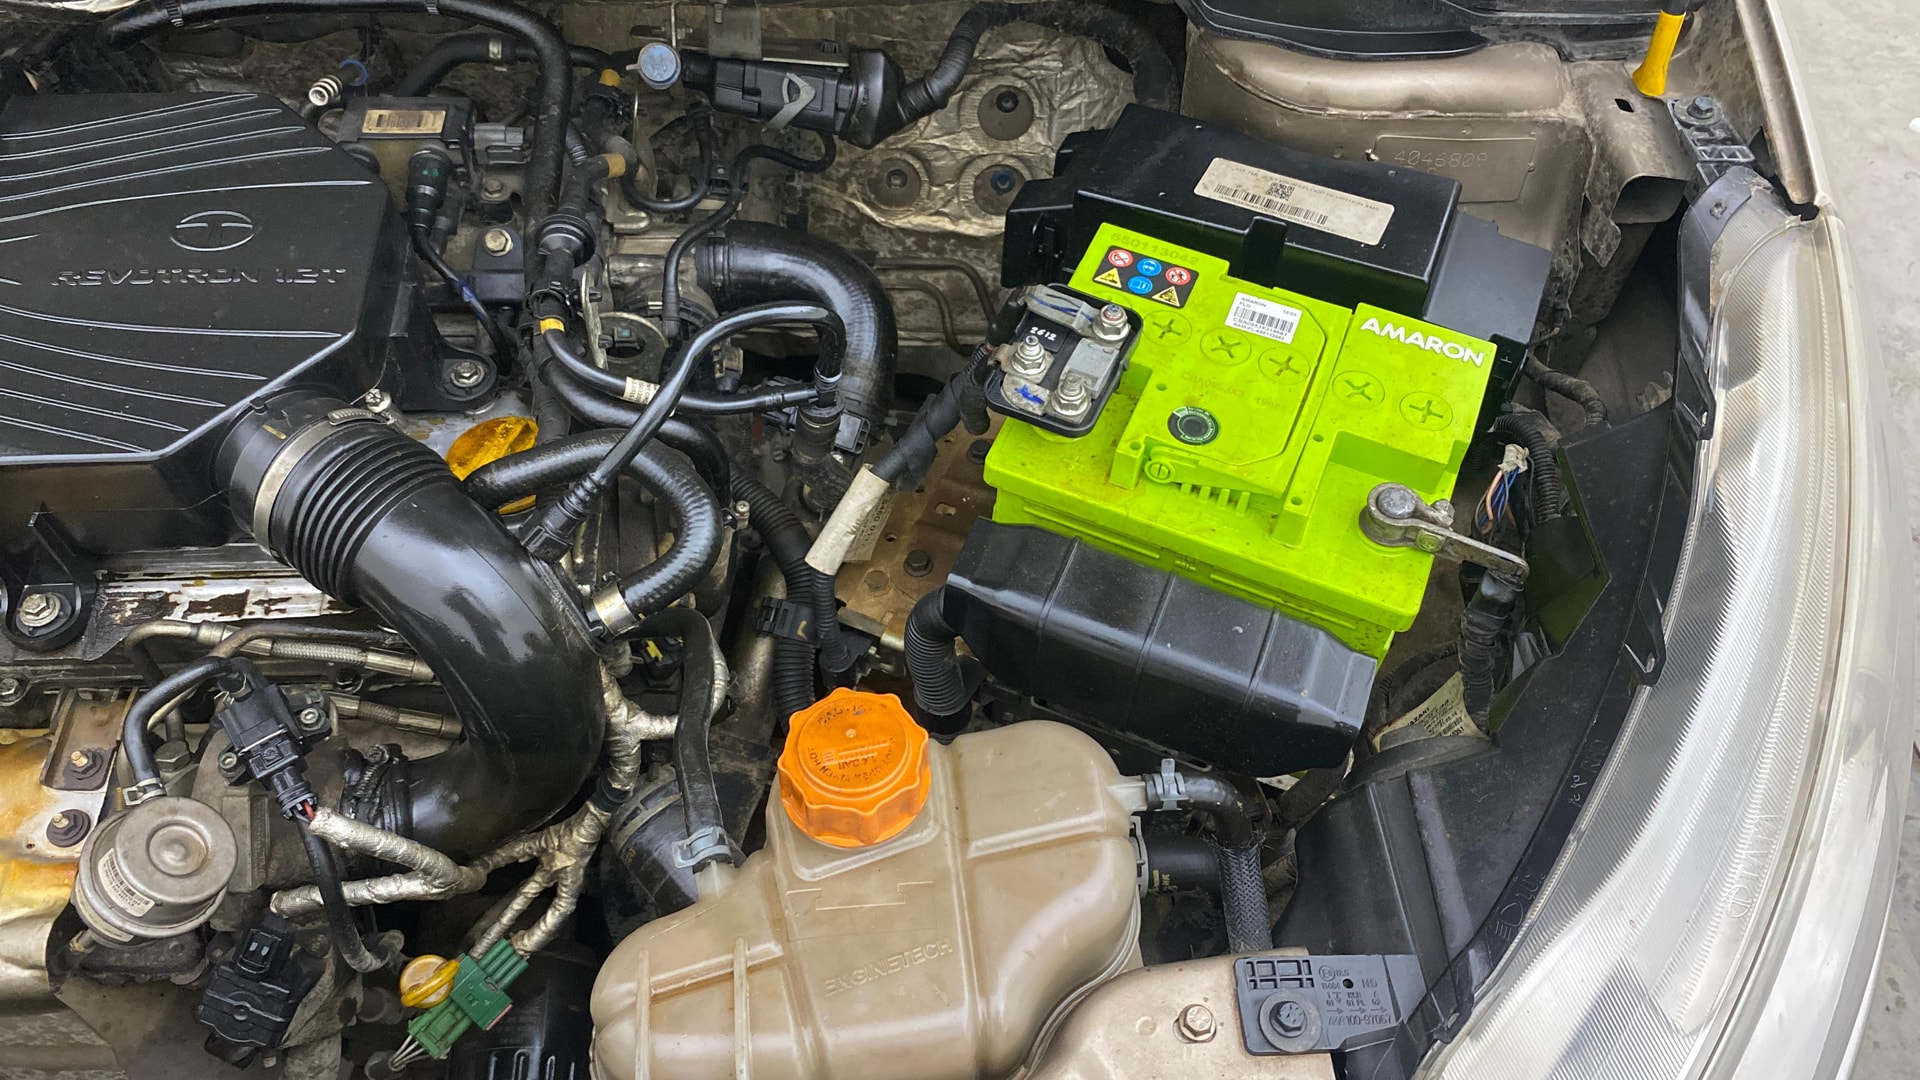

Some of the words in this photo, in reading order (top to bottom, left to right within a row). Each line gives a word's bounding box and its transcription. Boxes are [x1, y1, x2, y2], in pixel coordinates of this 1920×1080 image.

[1029, 326, 1057, 342] 2612
[1360, 317, 1484, 367] AMARON
[824, 937, 953, 997] ENGINETECH
